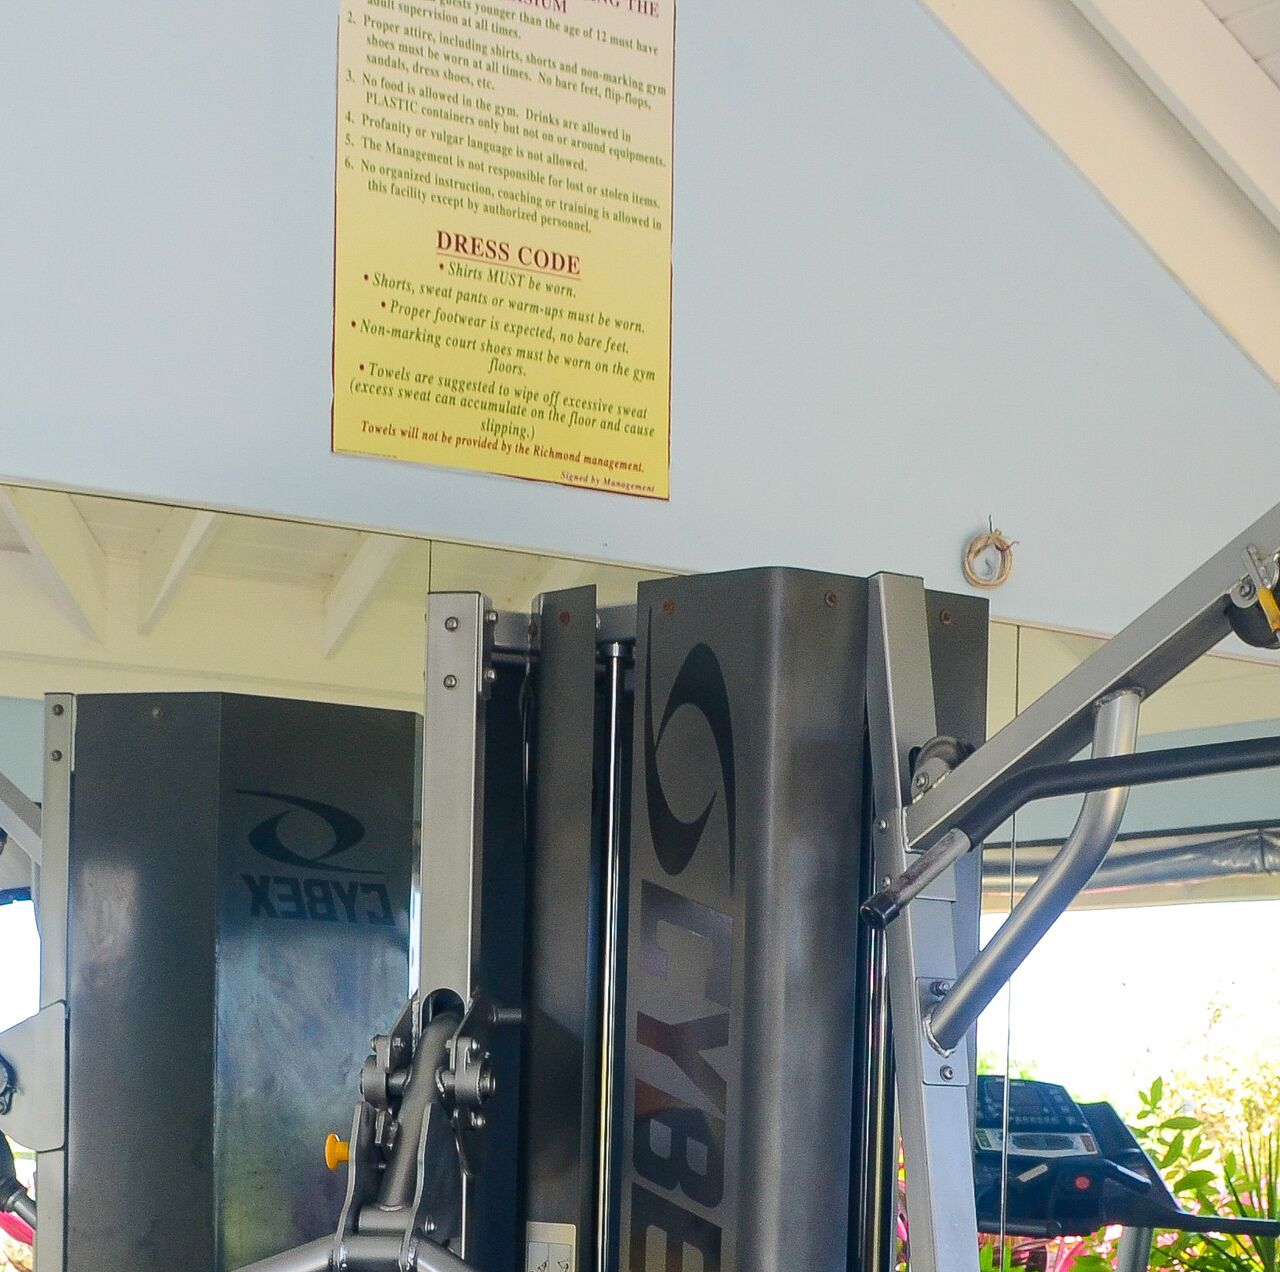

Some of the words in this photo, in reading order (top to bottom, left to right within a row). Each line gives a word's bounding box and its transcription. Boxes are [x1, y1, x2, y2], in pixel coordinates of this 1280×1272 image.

[628, 0, 660, 18] THE
[366, 91, 418, 113] PLASTIC
[421, 106, 474, 125] containers
[477, 117, 499, 133] only
[502, 120, 519, 135] but
[522, 128, 538, 139] not
[541, 132, 553, 142] on
[556, 136, 567, 145] or
[570, 139, 605, 153] around
[608, 147, 665, 166] equipments.
[344, 132, 354, 146] 5.
[360, 135, 381, 151] The
[385, 140, 452, 165] Management
[456, 154, 464, 168] is
[468, 160, 484, 172] not
[488, 165, 544, 184] responsible
[548, 174, 563, 188] for
[566, 177, 583, 192] lost
[586, 185, 597, 195] or
[600, 187, 629, 202] stolen
[632, 192, 660, 208] items.
[344, 156, 354, 169] 6.
[360, 158, 376, 173] No
[379, 166, 431, 183] organized
[434, 173, 494, 197] instruction,
[497, 189, 542, 208] coaching
[544, 198, 556, 208] or
[559, 200, 599, 219] training
[602, 207, 609, 219] is
[612, 210, 649, 227] allowed
[652, 217, 661, 230] in
[368, 179, 387, 193] this
[390, 182, 426, 203] facility
[430, 194, 463, 209] except
[467, 196, 478, 214] by
[483, 203, 537, 222] authorized
[540, 215, 591, 232] personnel.
[438, 231, 509, 260] DRESS
[518, 247, 579, 274] CODE
[448, 261, 482, 279] Shirts
[486, 268, 525, 287] MUST
[528, 275, 541, 290] be
[545, 283, 575, 297] worn.
[372, 272, 414, 294] Shorts,
[419, 284, 452, 299] sweat
[455, 290, 487, 304] pants
[491, 297, 504, 307] or
[508, 299, 563, 320] warm-ups
[567, 310, 594, 324] must
[598, 311, 610, 327] be
[614, 319, 644, 333] worn.
[390, 299, 431, 320] Proper
[432, 306, 486, 327] footwear
[490, 316, 499, 330] is
[503, 322, 555, 342] expected,
[559, 332, 573, 343] no
[577, 331, 602, 348] bare
[603, 336, 628, 353] feet.
[360, 319, 441, 347] Non-marking
[445, 336, 476, 350] court
[480, 338, 512, 356] shoes
[516, 348, 543, 361] must
[546, 349, 559, 364] be
[564, 356, 591, 370] worn
[594, 362, 608, 373] on
[612, 361, 629, 376] the
[632, 369, 655, 382] gym
[487, 356, 525, 376] floors.
[349, 379, 393, 396] (excess
[397, 388, 431, 401] sweat
[434, 393, 456, 405] can
[460, 397, 526, 416] accumulate
[530, 408, 544, 419] on
[548, 407, 566, 423] the
[567, 410, 597, 427] floor
[600, 418, 621, 431] and
[624, 423, 655, 436] cause
[369, 362, 410, 381] Towels
[414, 373, 434, 384] are
[437, 376, 495, 394] suggested
[498, 384, 509, 396] to
[514, 386, 539, 403] wipe
[542, 390, 560, 409] off
[562, 397, 613, 413] excessive
[616, 406, 647, 419] sweat
[362, 420, 396, 436] Towels
[400, 426, 419, 439] will
[421, 431, 438, 441] not
[441, 431, 452, 444] be
[454, 436, 498, 450] provided
[500, 439, 512, 455] by
[514, 441, 530, 455] the
[533, 444, 581, 462] Richmond
[583, 456, 643, 472] management.
[480, 418, 534, 440] slipping.)
